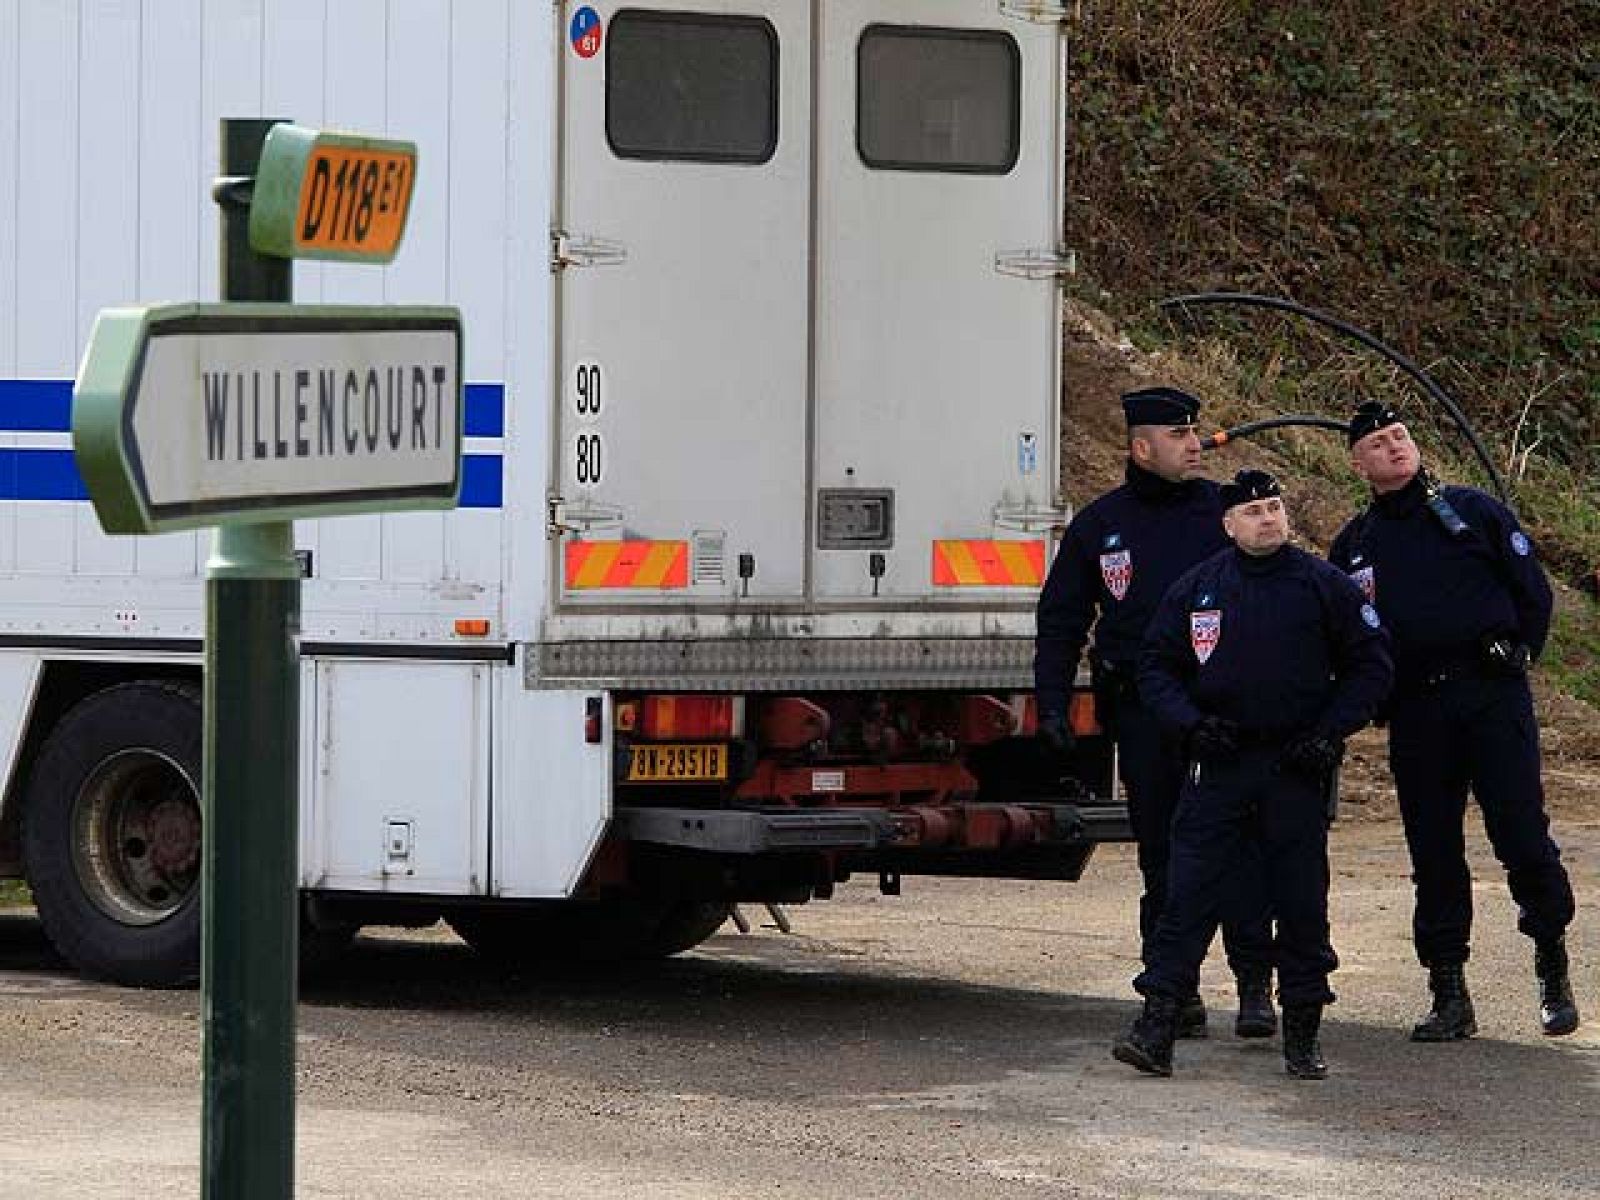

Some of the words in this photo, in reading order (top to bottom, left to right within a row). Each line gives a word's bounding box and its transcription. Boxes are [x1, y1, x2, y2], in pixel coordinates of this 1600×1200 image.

[203, 366, 447, 461] WILLENCOURT
[577, 364, 601, 415] 90
[577, 434, 601, 484] 80
